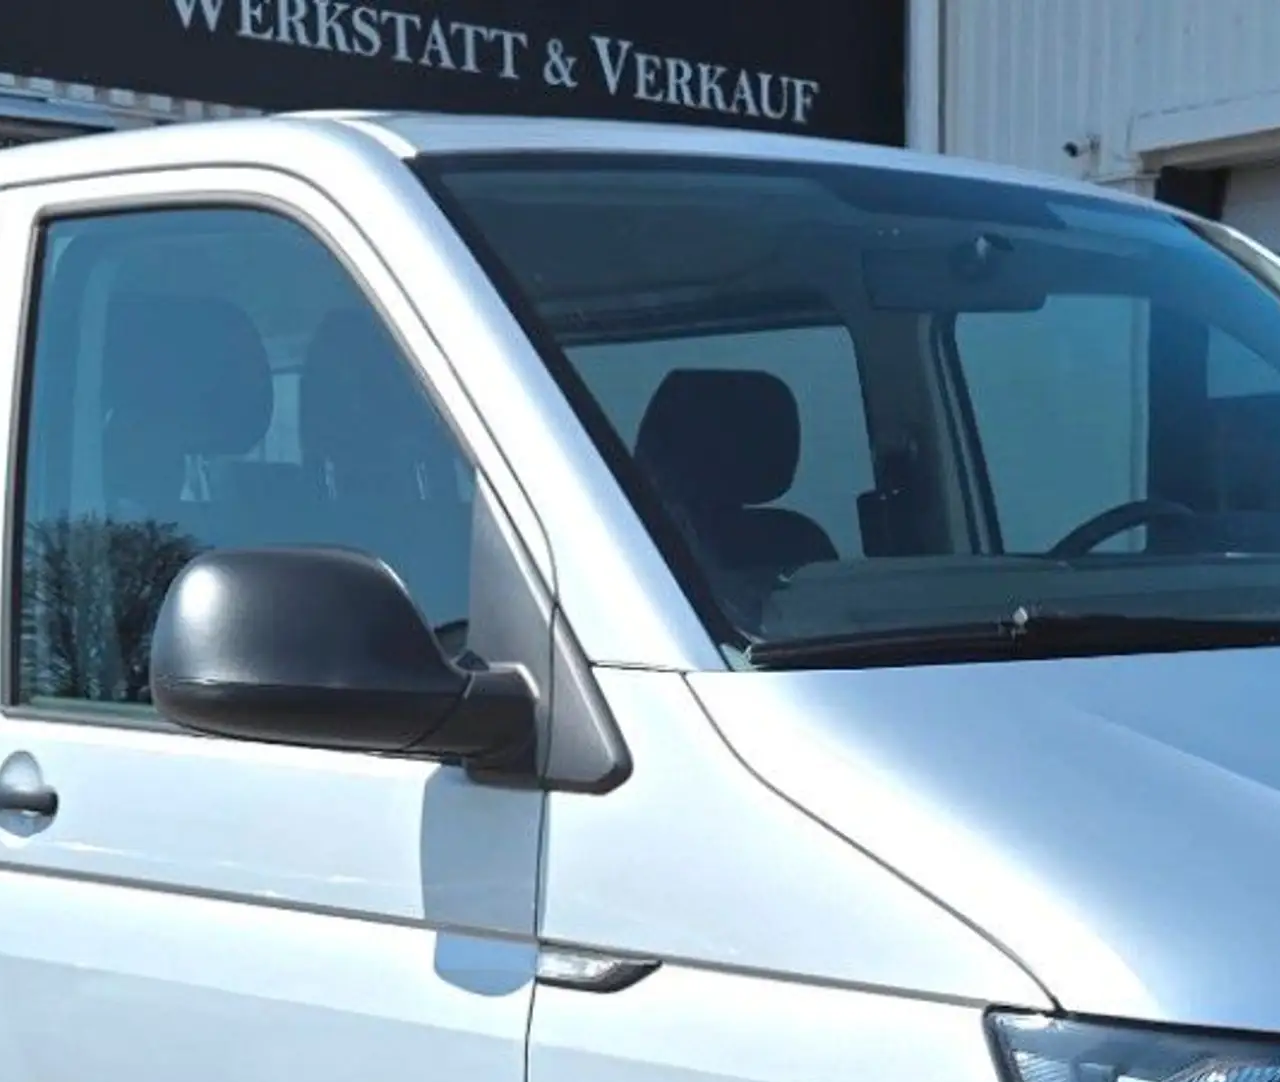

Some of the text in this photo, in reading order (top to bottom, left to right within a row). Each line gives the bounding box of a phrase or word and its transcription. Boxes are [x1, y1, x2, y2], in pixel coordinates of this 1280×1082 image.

[173, 0, 819, 124] WERKSTATT & VERKAUF
